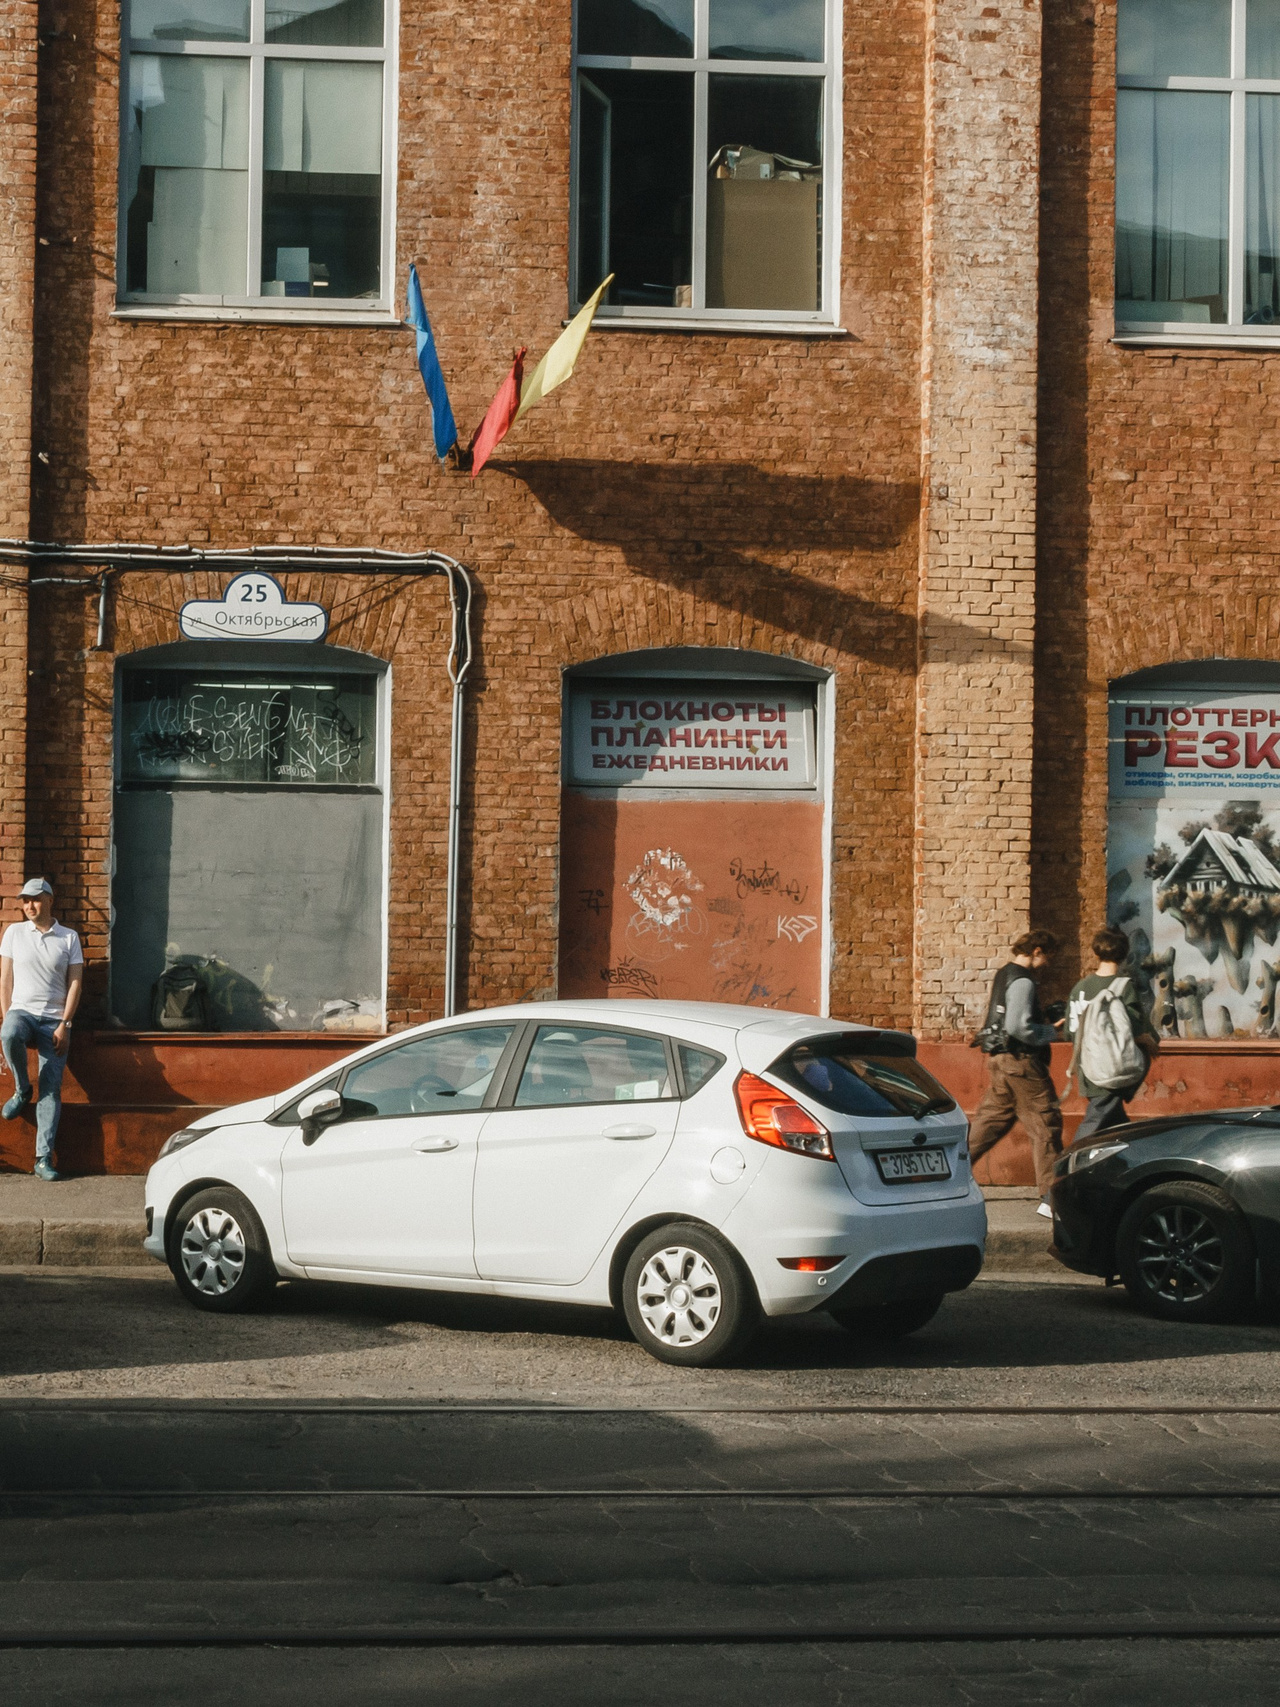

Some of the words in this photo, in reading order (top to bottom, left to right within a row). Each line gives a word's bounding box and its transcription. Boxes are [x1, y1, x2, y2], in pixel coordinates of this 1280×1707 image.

[240, 584, 267, 602] 25
[215, 611, 318, 629] Октябрьская
[590, 700, 786, 723] БЛОКНОТЫ
[590, 726, 788, 749] ПЛАНИНГИ
[1124, 730, 1280, 769] РЕЗК
[592, 754, 789, 772] ЕЖЕДНЕВНИКИ
